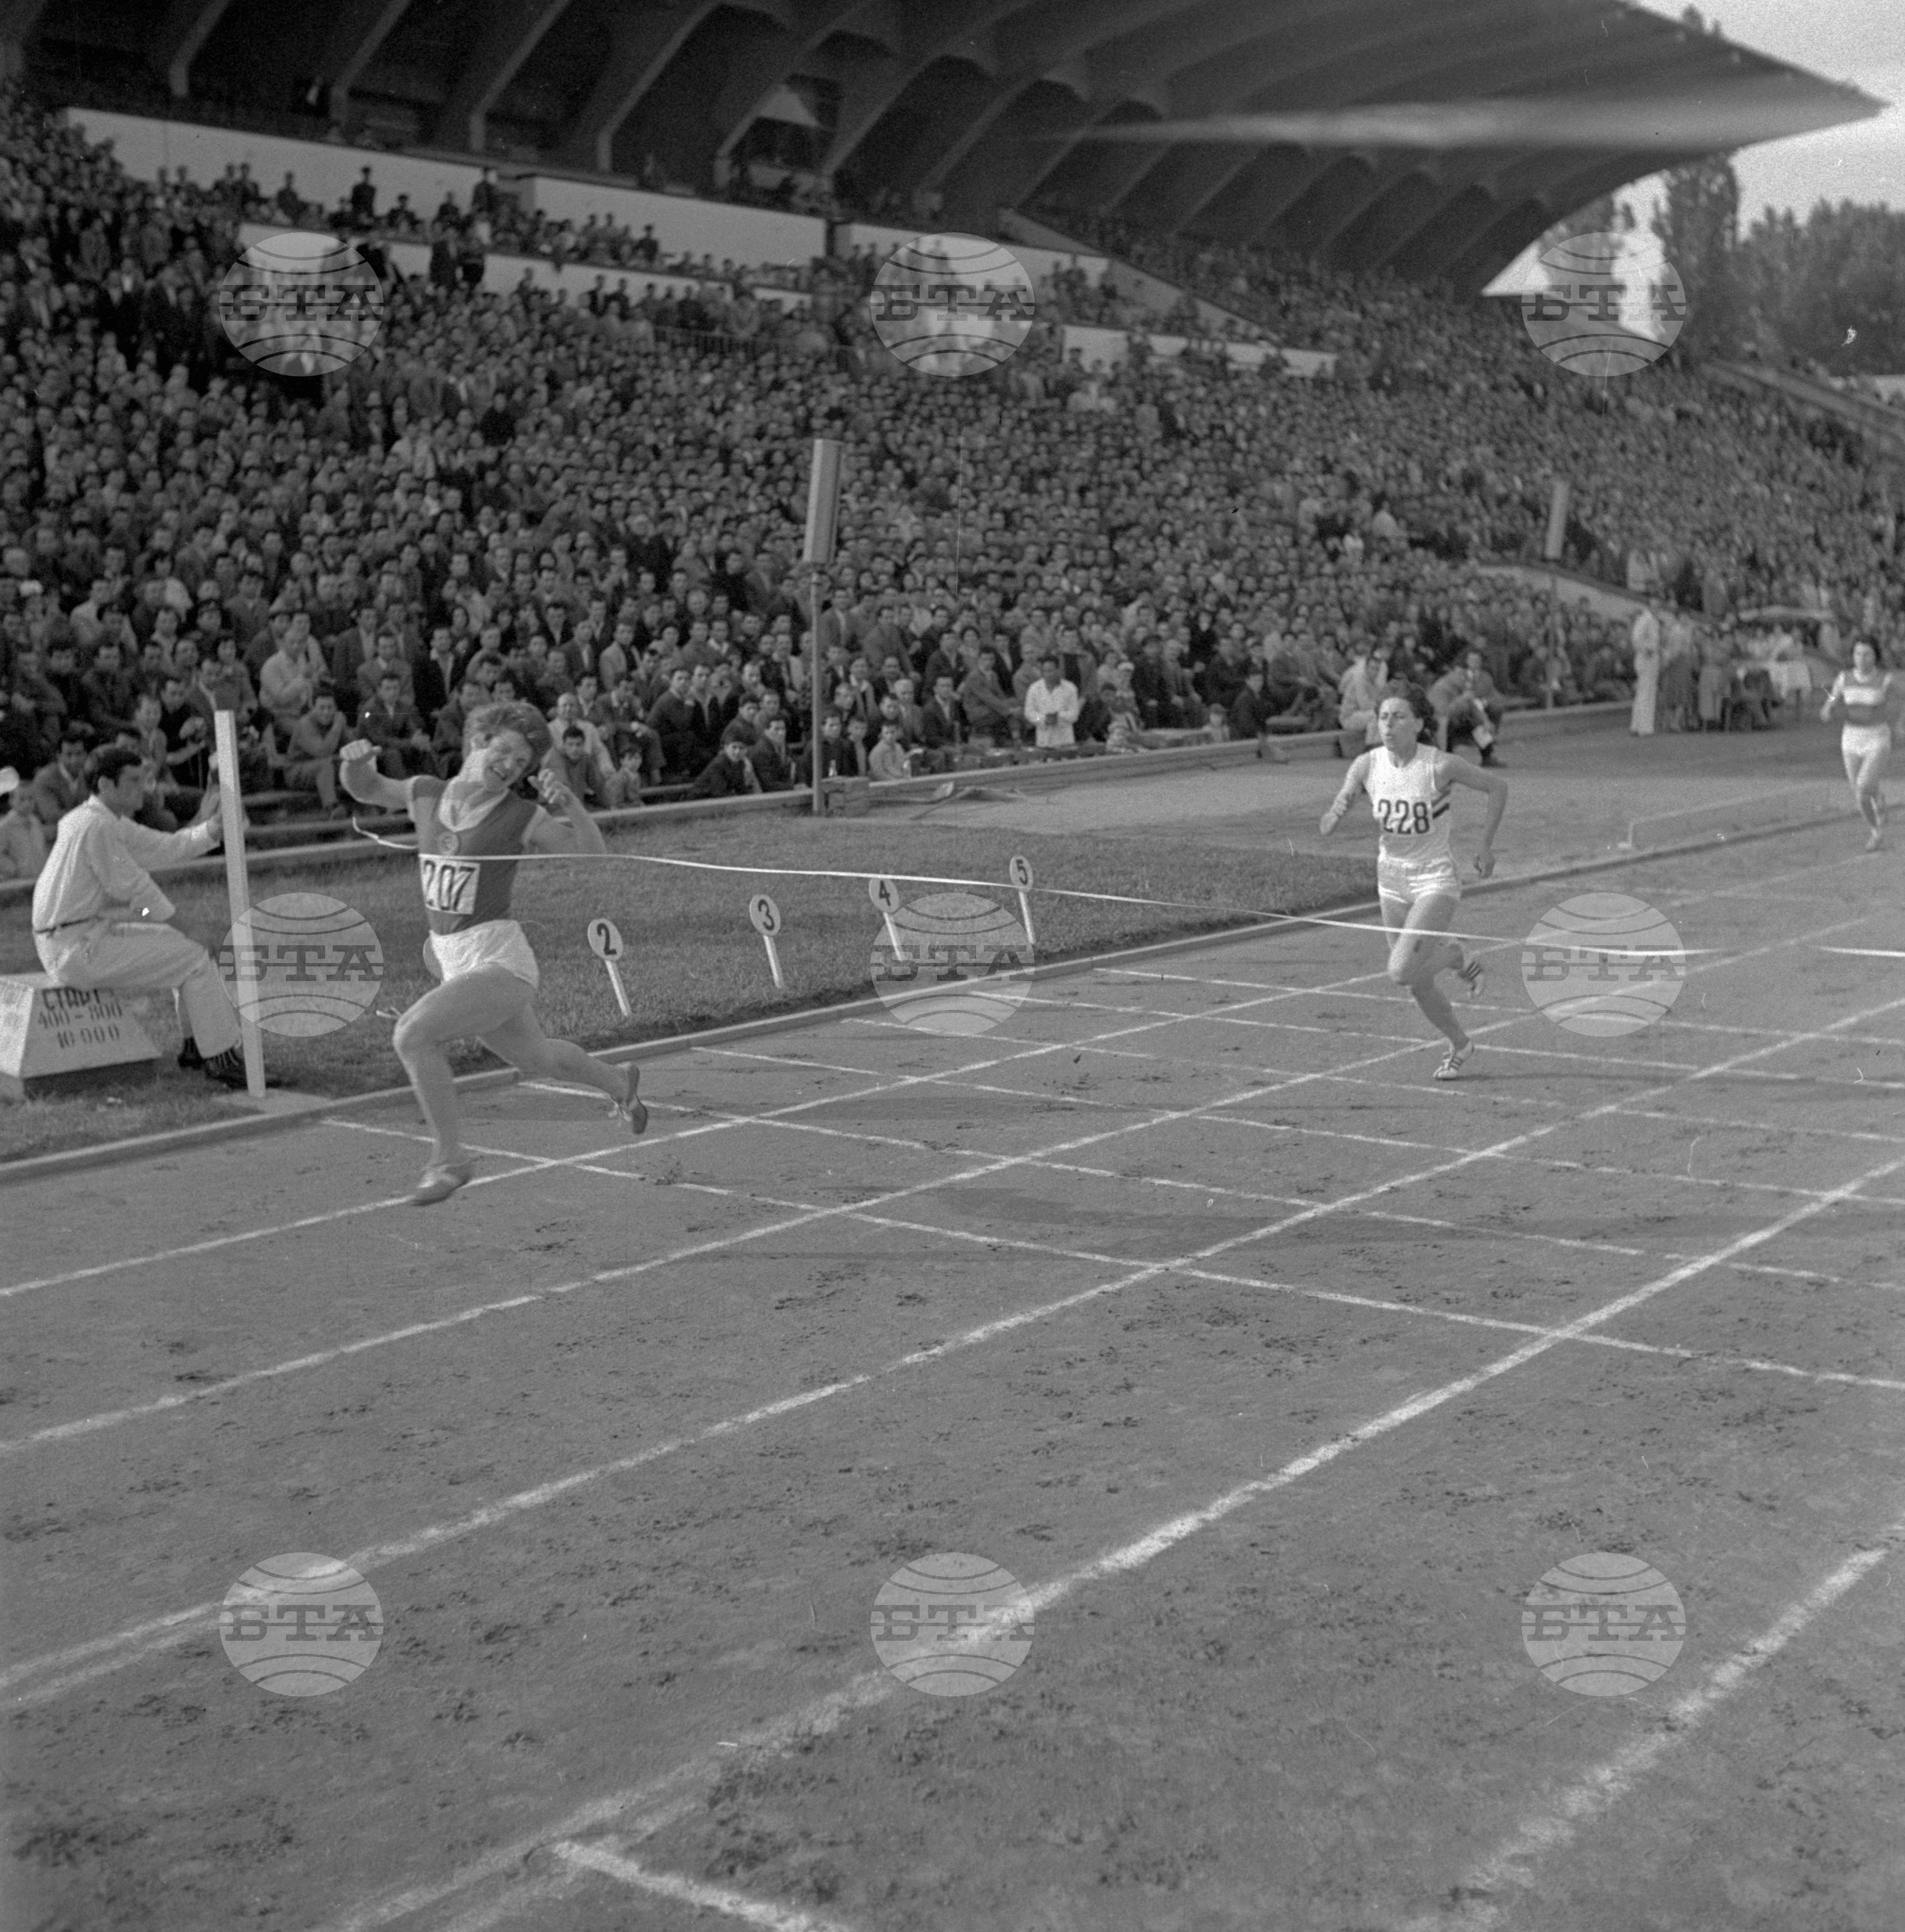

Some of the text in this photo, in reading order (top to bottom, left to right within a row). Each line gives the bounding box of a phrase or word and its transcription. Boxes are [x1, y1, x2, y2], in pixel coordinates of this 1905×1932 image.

[1378, 799, 1430, 835] 228
[424, 860, 476, 911] 207
[1016, 859, 1028, 885] 5
[879, 880, 891, 906] 4
[758, 899, 775, 931] 3
[596, 923, 617, 955] 2
